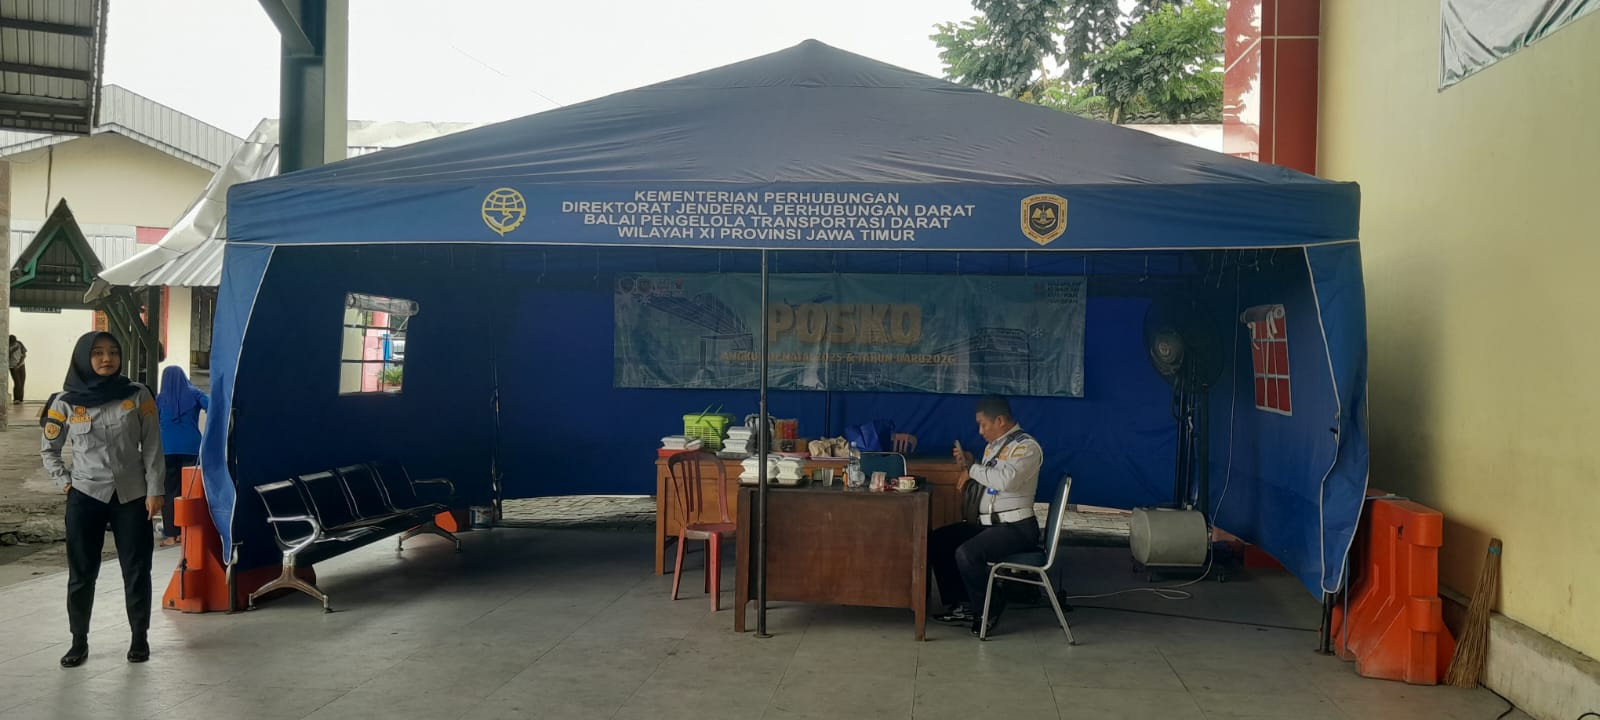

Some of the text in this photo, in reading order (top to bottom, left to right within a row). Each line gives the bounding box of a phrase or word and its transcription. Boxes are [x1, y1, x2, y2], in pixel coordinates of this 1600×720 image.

[634, 191, 900, 204] KEMENTERIAN PERHUBUNGAN
[561, 202, 976, 217] DIREKTORAT JENDERAL PERHUBUNGAN DARAT
[583, 214, 952, 229] BALAI PENGELOLA TRANSPORTASI DARAT
[617, 226, 916, 241] WILAYAH XI PROVINSI JAWA TIMUR
[766, 303, 922, 345] POSKO
